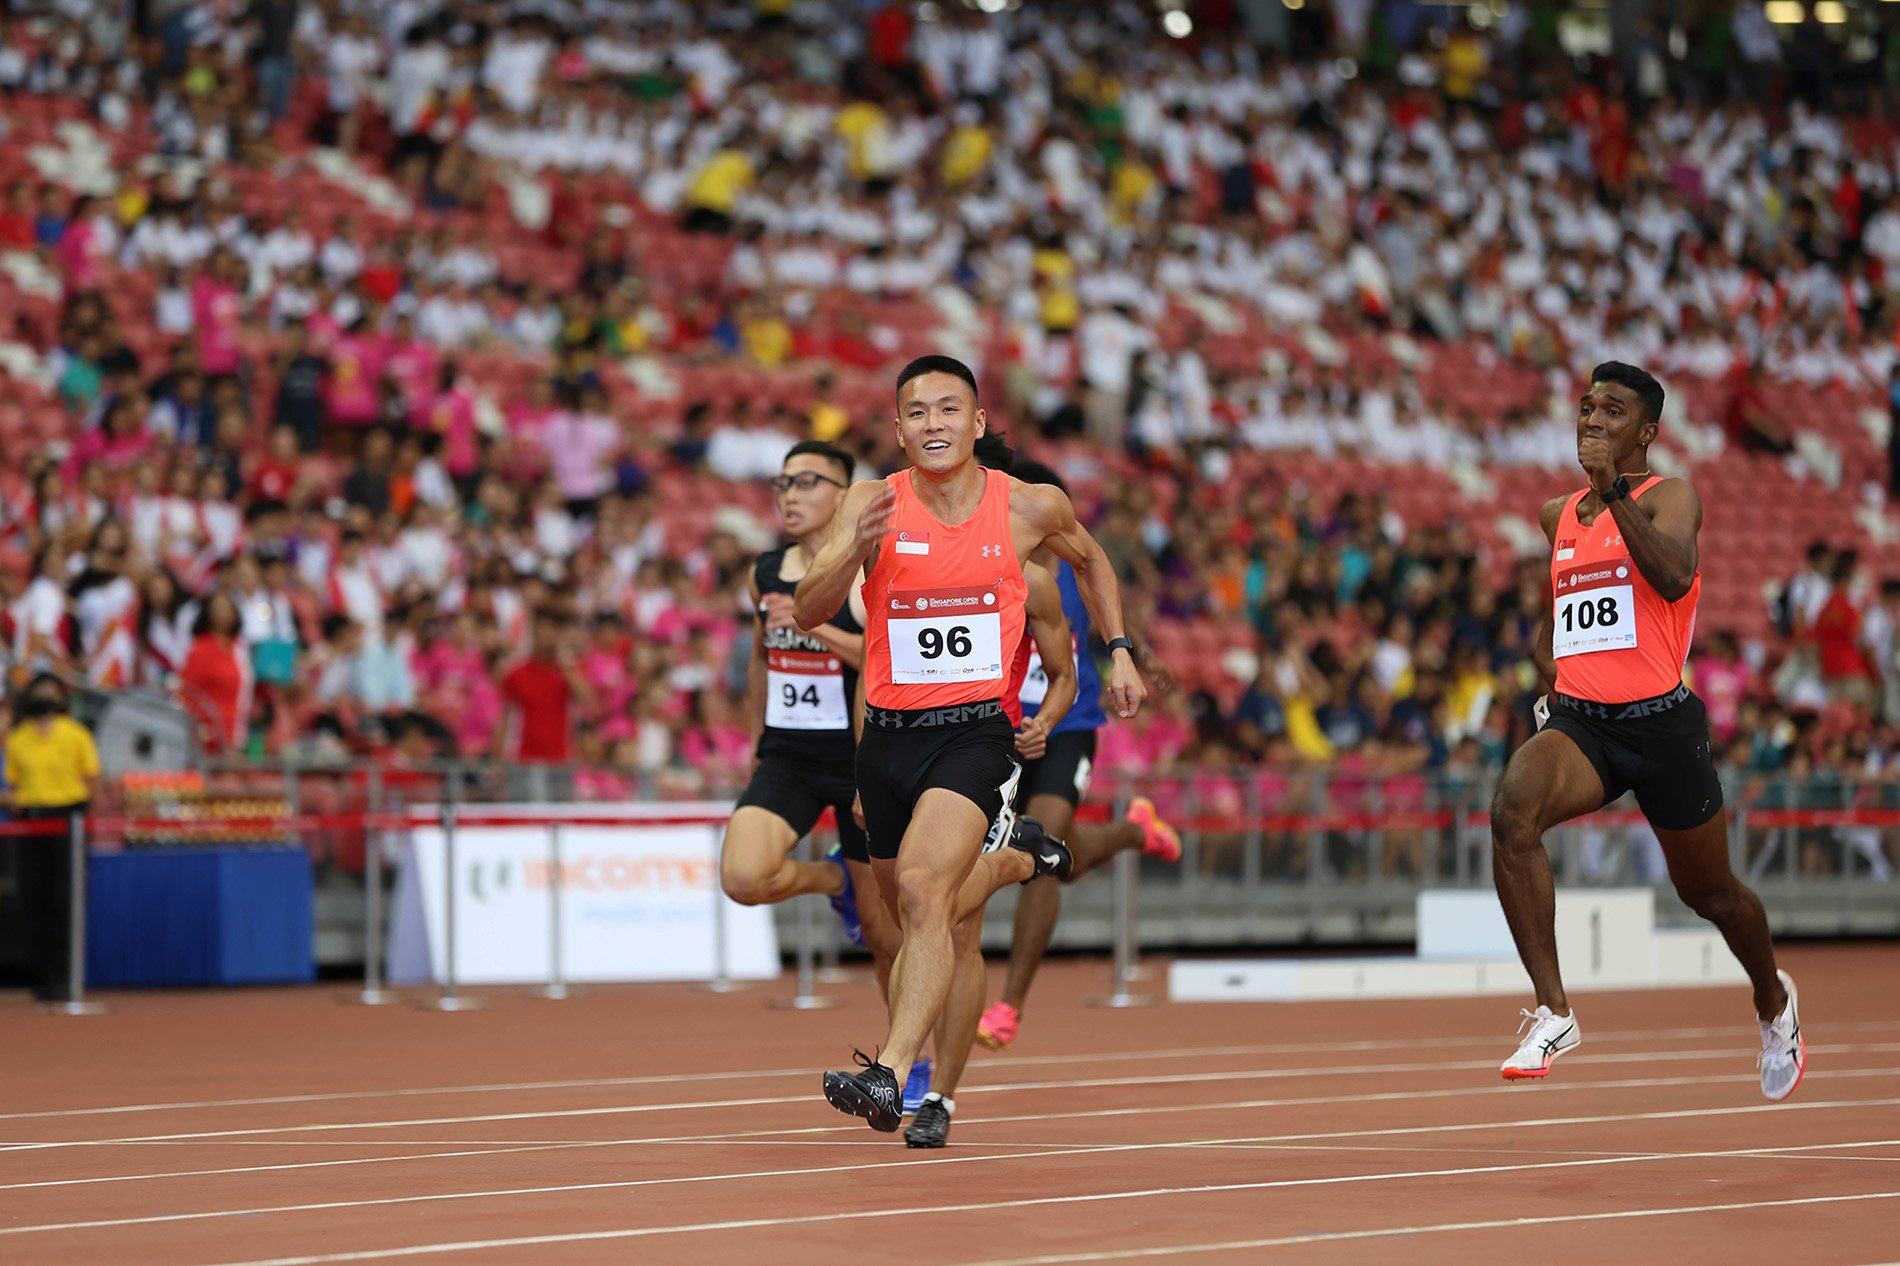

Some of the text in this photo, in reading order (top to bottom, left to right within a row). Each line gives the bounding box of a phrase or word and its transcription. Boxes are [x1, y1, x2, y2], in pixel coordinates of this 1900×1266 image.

[1562, 597, 1619, 632] 108
[918, 626, 972, 659] 96
[783, 683, 820, 708] 94
